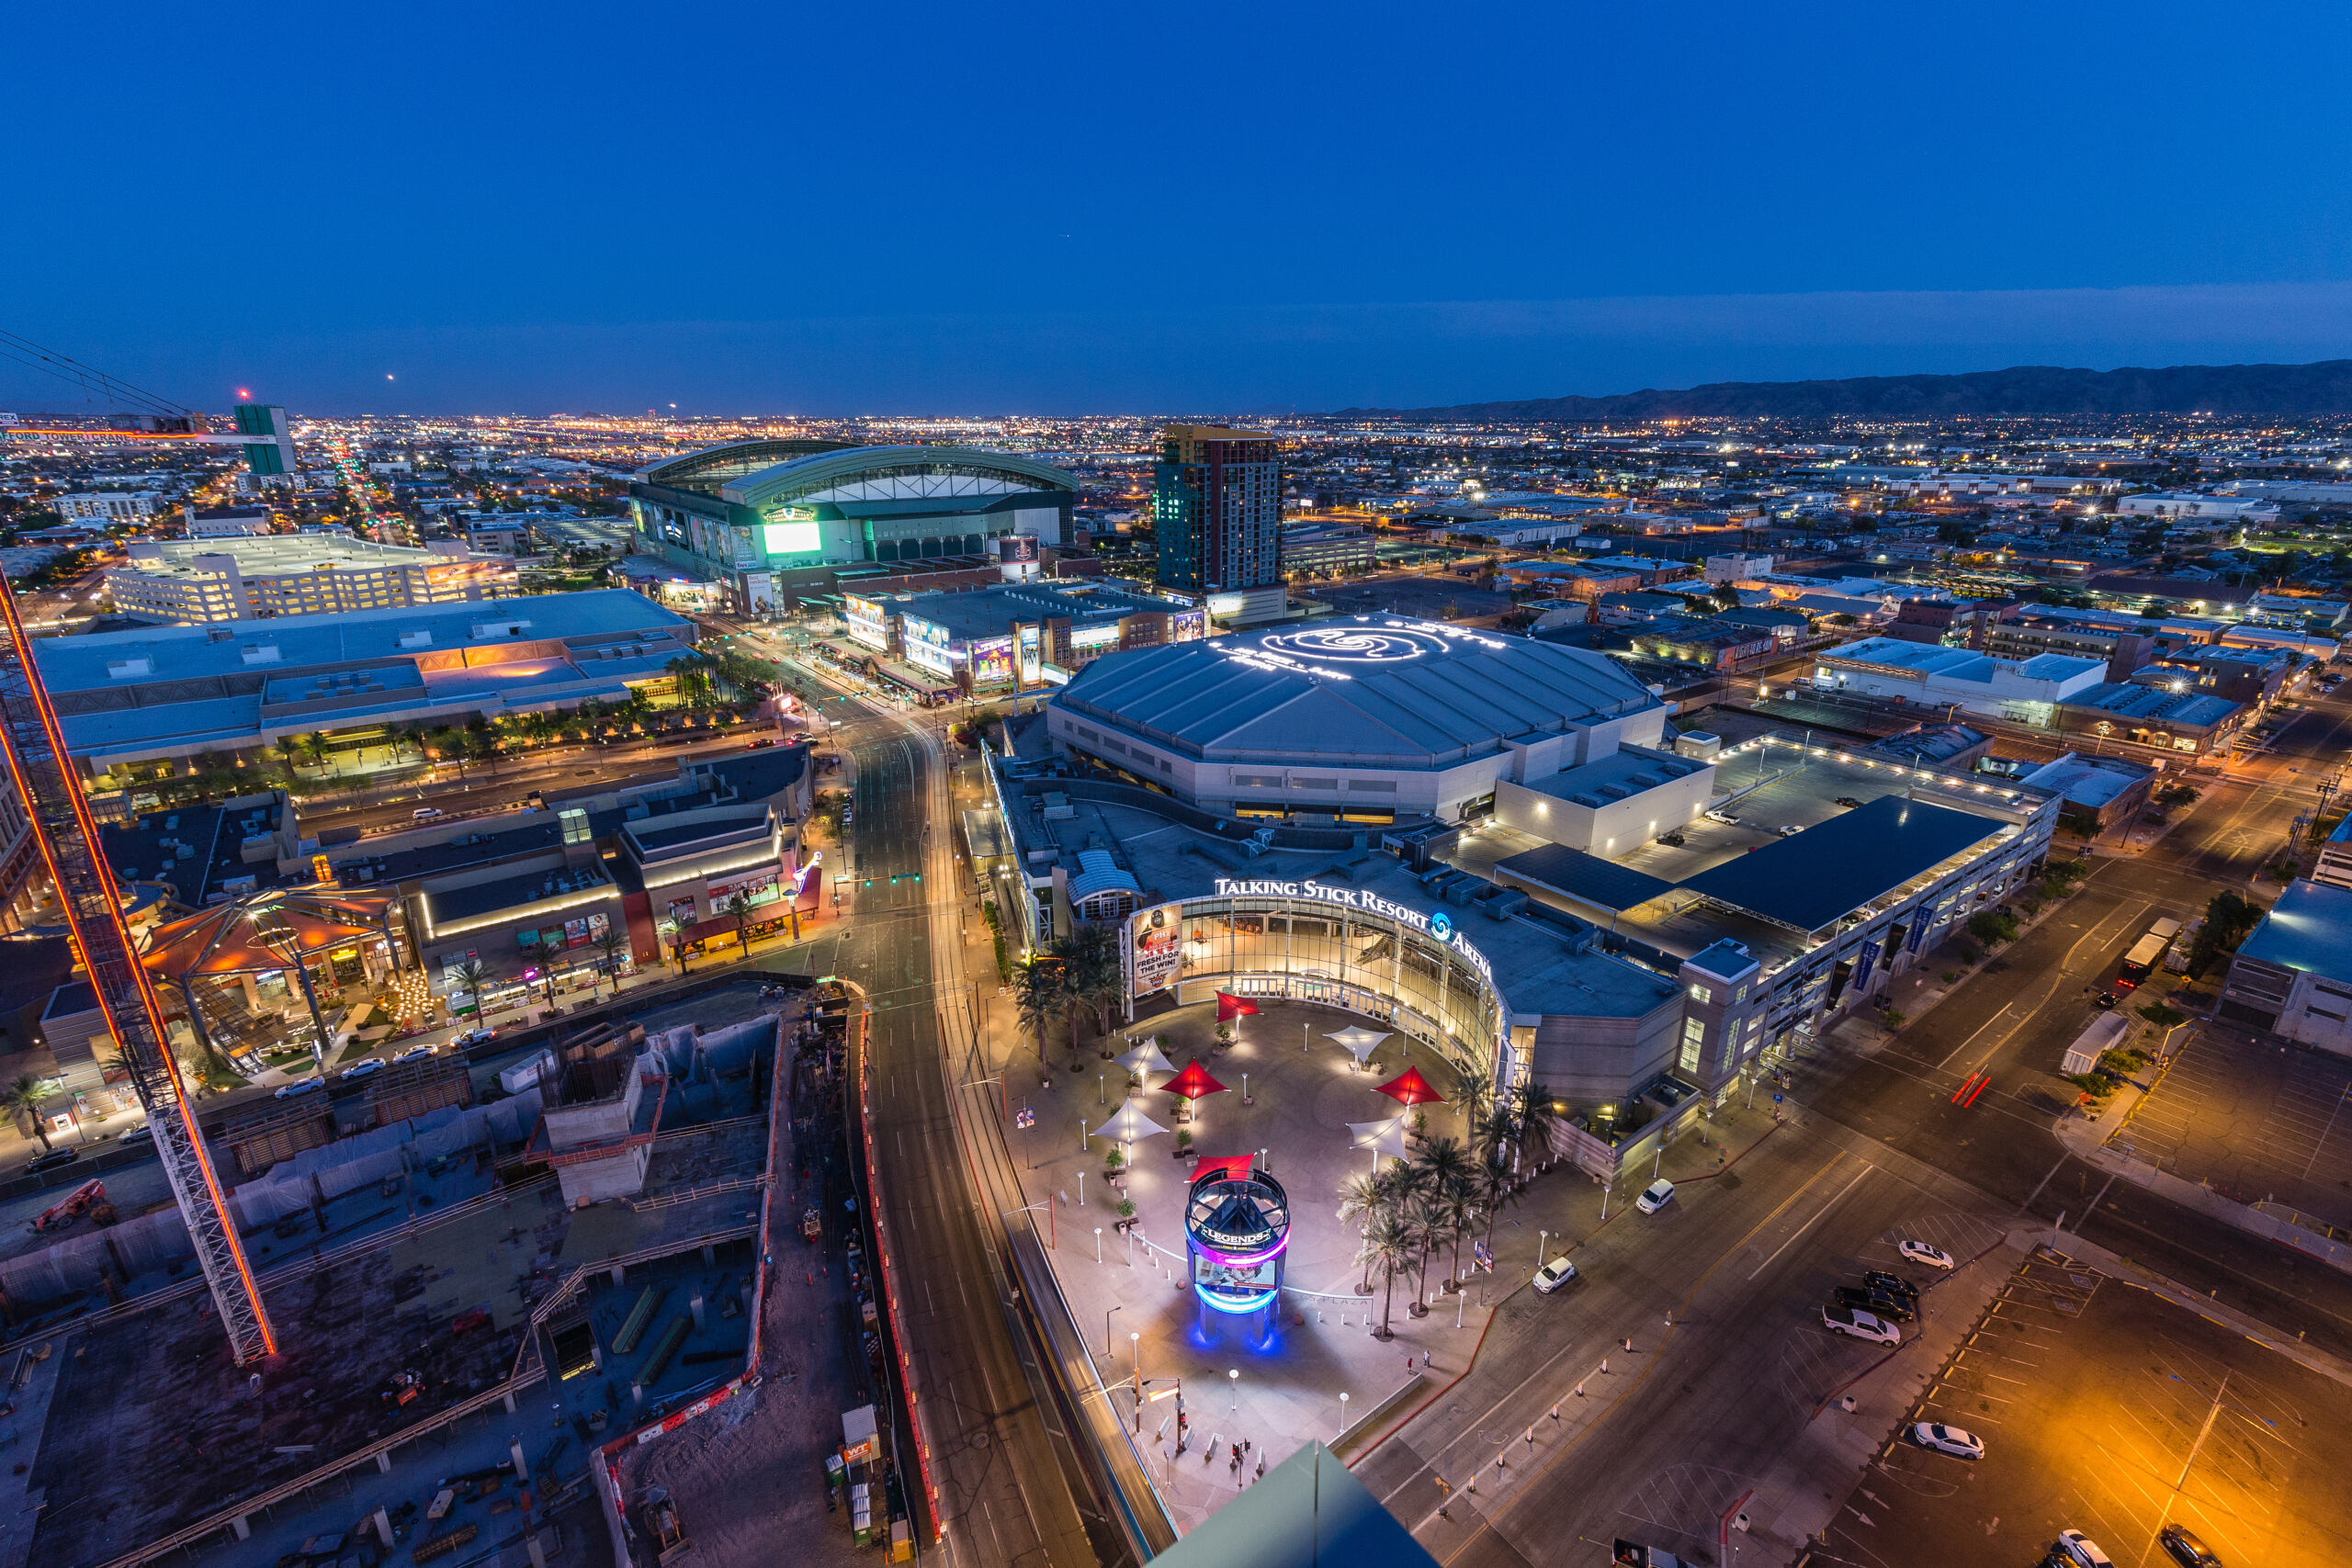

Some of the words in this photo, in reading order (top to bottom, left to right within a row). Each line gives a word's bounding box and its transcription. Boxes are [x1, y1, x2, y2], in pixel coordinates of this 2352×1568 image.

[46, 433, 81, 441] TOWER
[1129, 640, 1159, 649] PARKING
[1215, 878, 1297, 896] TALKING
[1304, 880, 1358, 906] STICK
[1362, 889, 1430, 930] RESORT
[1452, 931, 1493, 983] ARENA
[1137, 955, 1161, 968] FRESH
[1162, 951, 1180, 961] FOR
[1140, 964, 1156, 974] THE
[1157, 958, 1176, 969] WIN!
[1208, 1227, 1263, 1244] LEGENDS
[847, 1442, 868, 1456] WT
